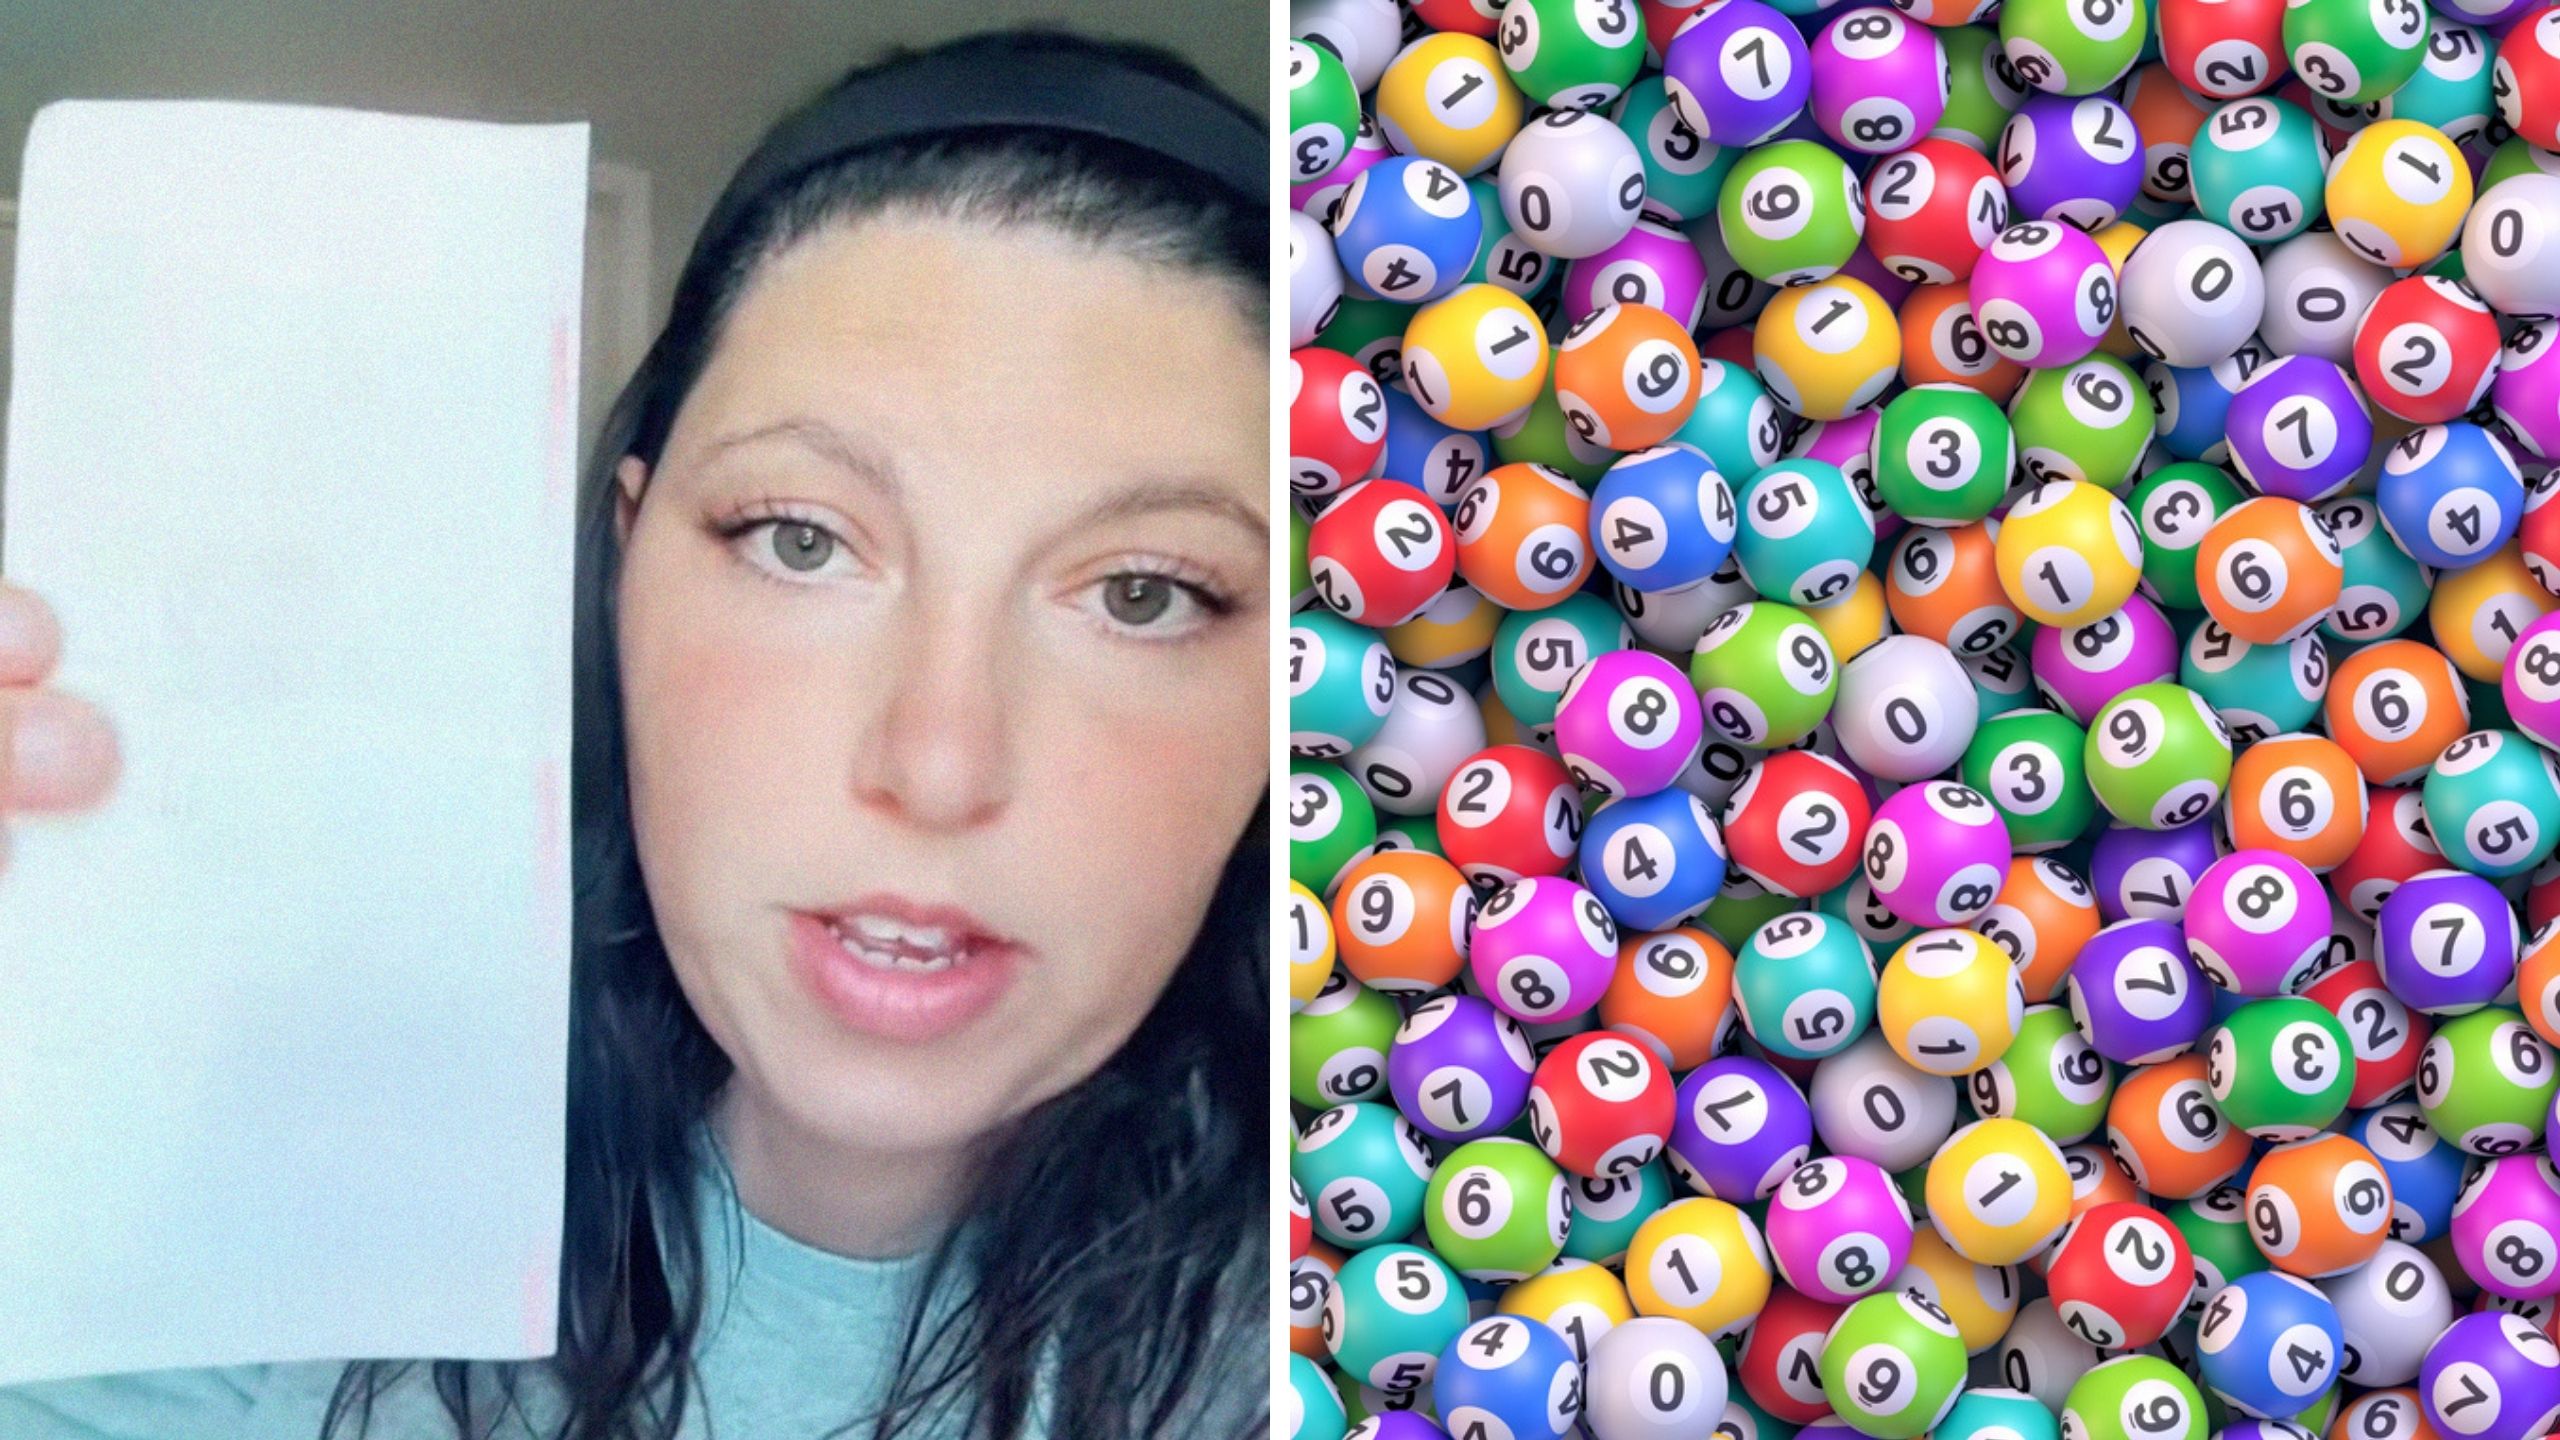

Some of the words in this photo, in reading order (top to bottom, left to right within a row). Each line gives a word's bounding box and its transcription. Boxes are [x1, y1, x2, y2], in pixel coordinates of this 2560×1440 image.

[1502, 15, 1528, 56] 3
[1843, 15, 1891, 41] 8
[2430, 30, 2477, 61] 5
[1733, 37, 1771, 88] 7
[2205, 55, 2257, 87] 2
[2304, 55, 2346, 94] 3
[1442, 74, 1483, 110] 1
[1852, 115, 1903, 143] 8
[2094, 106, 2123, 148] 7
[2220, 105, 2267, 135] 5
[1296, 136, 1329, 175] 3
[2398, 152, 2441, 183] 1
[1427, 167, 1458, 201] 4
[1620, 173, 1643, 210] 0
[1881, 160, 1916, 205] 2
[1520, 185, 1551, 232] 0
[2241, 202, 2292, 233] 5
[2002, 225, 2049, 245] 8
[2345, 231, 2386, 262] 1
[2491, 209, 2523, 257] 0
[1380, 257, 1421, 292] 4
[1498, 249, 1541, 284] 5
[2192, 258, 2233, 301] 0
[1718, 271, 1753, 311] 0
[2090, 277, 2114, 324] 8
[2297, 288, 2346, 322] 0
[1811, 300, 1851, 334] 1
[1986, 319, 2030, 350] 8
[1491, 326, 1530, 355] 1
[1950, 313, 1988, 364] 6
[2508, 325, 2542, 354] 8
[2390, 336, 2435, 387] 2
[1353, 383, 1381, 431] 2
[1926, 430, 1961, 478] 3
[2276, 407, 2314, 459] 7
[1444, 447, 1476, 495] 4
[1716, 482, 1734, 526] 4
[1758, 483, 1806, 521] 5
[2154, 491, 2200, 534] 3
[1386, 513, 1432, 558] 2
[1612, 518, 1654, 553] 4
[2446, 505, 2480, 546] 4
[1903, 537, 1938, 580] 6
[2230, 552, 2271, 599] 6
[1315, 568, 1351, 613] 2
[1801, 573, 1850, 604] 5
[2039, 561, 2071, 605] 1
[2072, 615, 2120, 658] 8
[2335, 602, 2388, 632] 5
[2491, 609, 2518, 643] 1
[1526, 638, 1574, 671] 5
[1792, 636, 1827, 680] 9
[2304, 639, 2325, 687] 5
[2525, 645, 2560, 686] 8
[1375, 652, 1395, 703] 5
[1407, 674, 1455, 705] 0
[1624, 689, 1666, 735] 8
[1713, 700, 1755, 743] 9
[1886, 698, 1927, 744] 0
[2371, 680, 2409, 728] 6
[2110, 710, 2146, 753] 9
[2445, 733, 2489, 762] 5
[1366, 763, 1411, 799] 0
[1457, 768, 1493, 812] 2
[1939, 787, 1984, 808] 8
[2009, 754, 2045, 802] 3
[1290, 784, 1328, 826] 3
[1554, 797, 1583, 842] 2
[2280, 778, 2314, 827] 6
[1790, 804, 1836, 855] 2
[2477, 817, 2529, 855] 5
[1623, 836, 1657, 881] 4
[1867, 832, 1893, 881] 8
[1950, 884, 1993, 912] 8
[2129, 875, 2181, 908] 7
[2237, 876, 2284, 918] 8
[1290, 905, 1308, 950] 1
[1585, 900, 1615, 942] 8
[1764, 917, 1812, 945] 5
[2430, 918, 2464, 966] 7
[1916, 939, 1963, 953] 1
[1510, 969, 1555, 1010] 8
[2125, 962, 2176, 995] 7
[1794, 1008, 1844, 1041] 5
[2353, 998, 2399, 1051] 2
[1917, 1039, 1966, 1055] 1
[2292, 1033, 2324, 1081] 3
[1589, 1051, 1640, 1086] 2
[1430, 1078, 1469, 1126] 7
[1704, 1091, 1754, 1131] 7
[1863, 1085, 1905, 1132] 0
[1972, 1067, 2000, 1116] 9
[2176, 1091, 2217, 1137] 6
[2380, 1114, 2428, 1144] 4
[1793, 1163, 1827, 1196] 8
[1979, 1171, 2021, 1208] 1
[1330, 1188, 1375, 1234] 5
[1834, 1246, 1876, 1288] 8
[2116, 1226, 2165, 1270] 2
[2496, 1235, 2543, 1278] 8
[1397, 1260, 1430, 1300] 5
[1667, 1249, 1698, 1294] 1
[2386, 1261, 2424, 1301] 0
[2067, 1311, 2111, 1346] 2
[2202, 1295, 2231, 1338] 4
[1471, 1323, 1509, 1356] 4
[1565, 1316, 1586, 1363] 1
[1388, 1363, 1427, 1390] 5
[1858, 1358, 1900, 1404] 9
[2005, 1348, 2029, 1392] 0
[2287, 1344, 2324, 1382] 4
[1650, 1363, 1684, 1412] 0
[2443, 1375, 2488, 1417] 7
[2364, 1399, 2400, 1439] 6
